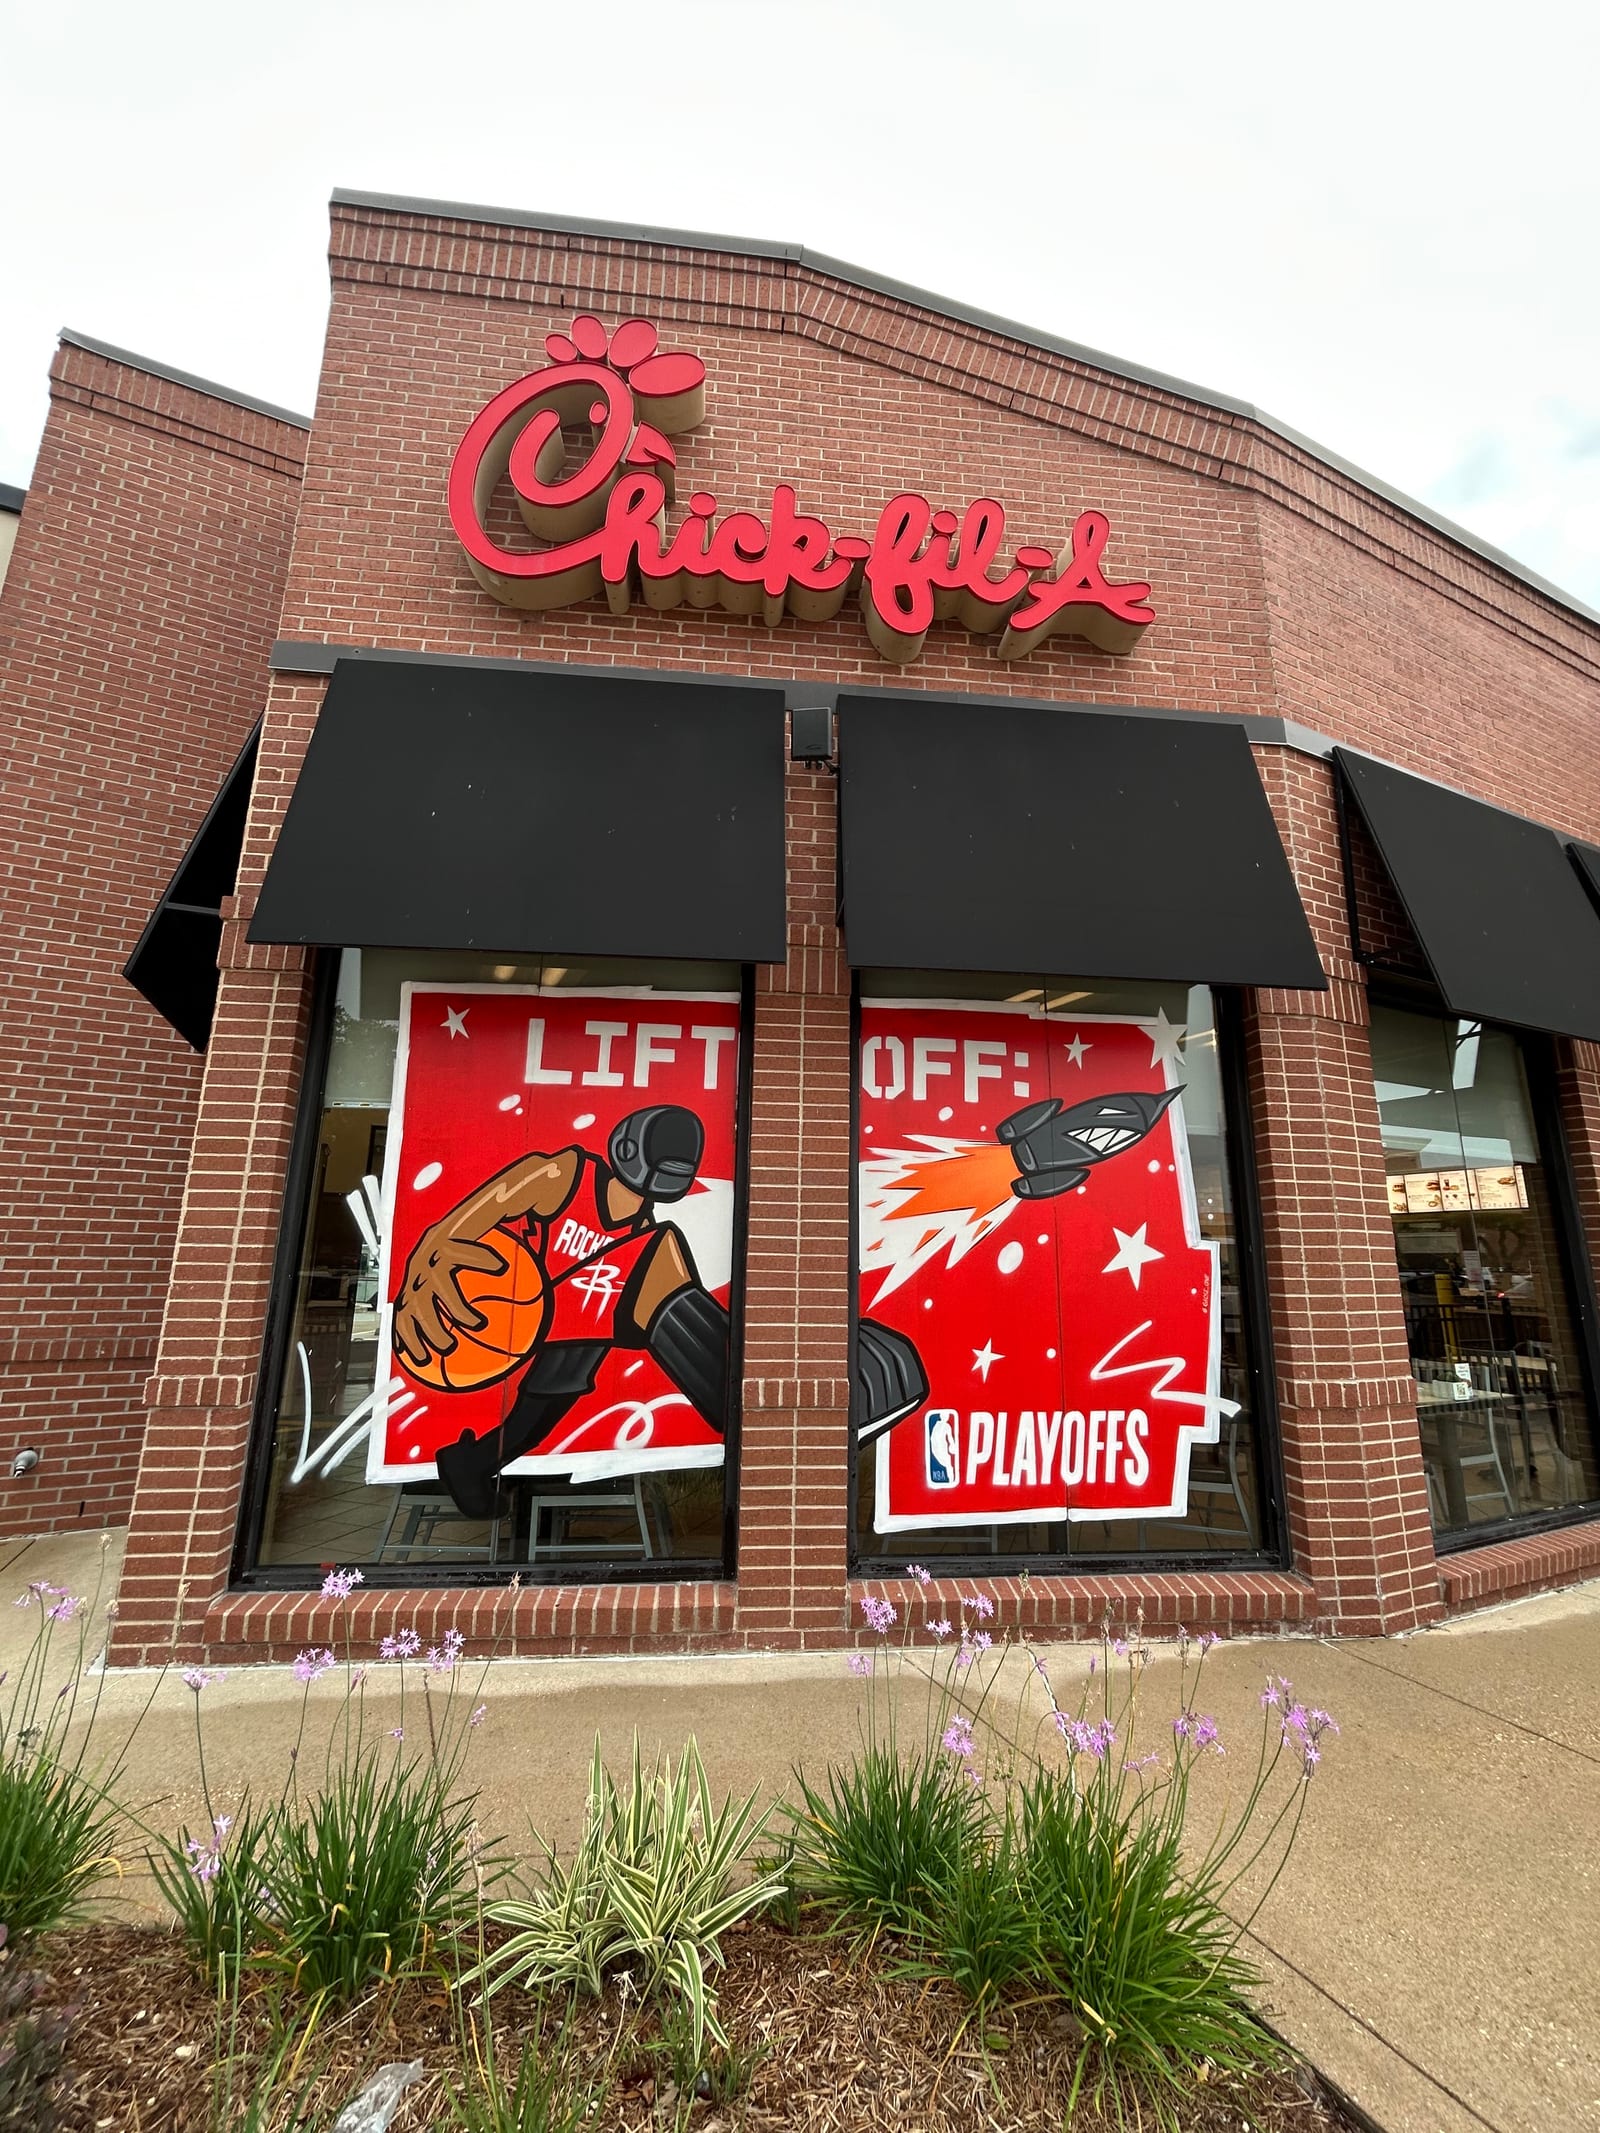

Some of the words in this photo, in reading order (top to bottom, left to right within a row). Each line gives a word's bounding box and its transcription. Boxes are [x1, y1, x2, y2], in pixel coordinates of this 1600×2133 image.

[448, 360, 1157, 635] Chick-fil-A
[524, 1017, 736, 1090] LIFT
[862, 1035, 1030, 1103] OFF:
[965, 1408, 1150, 1487] PLAYOFFS
